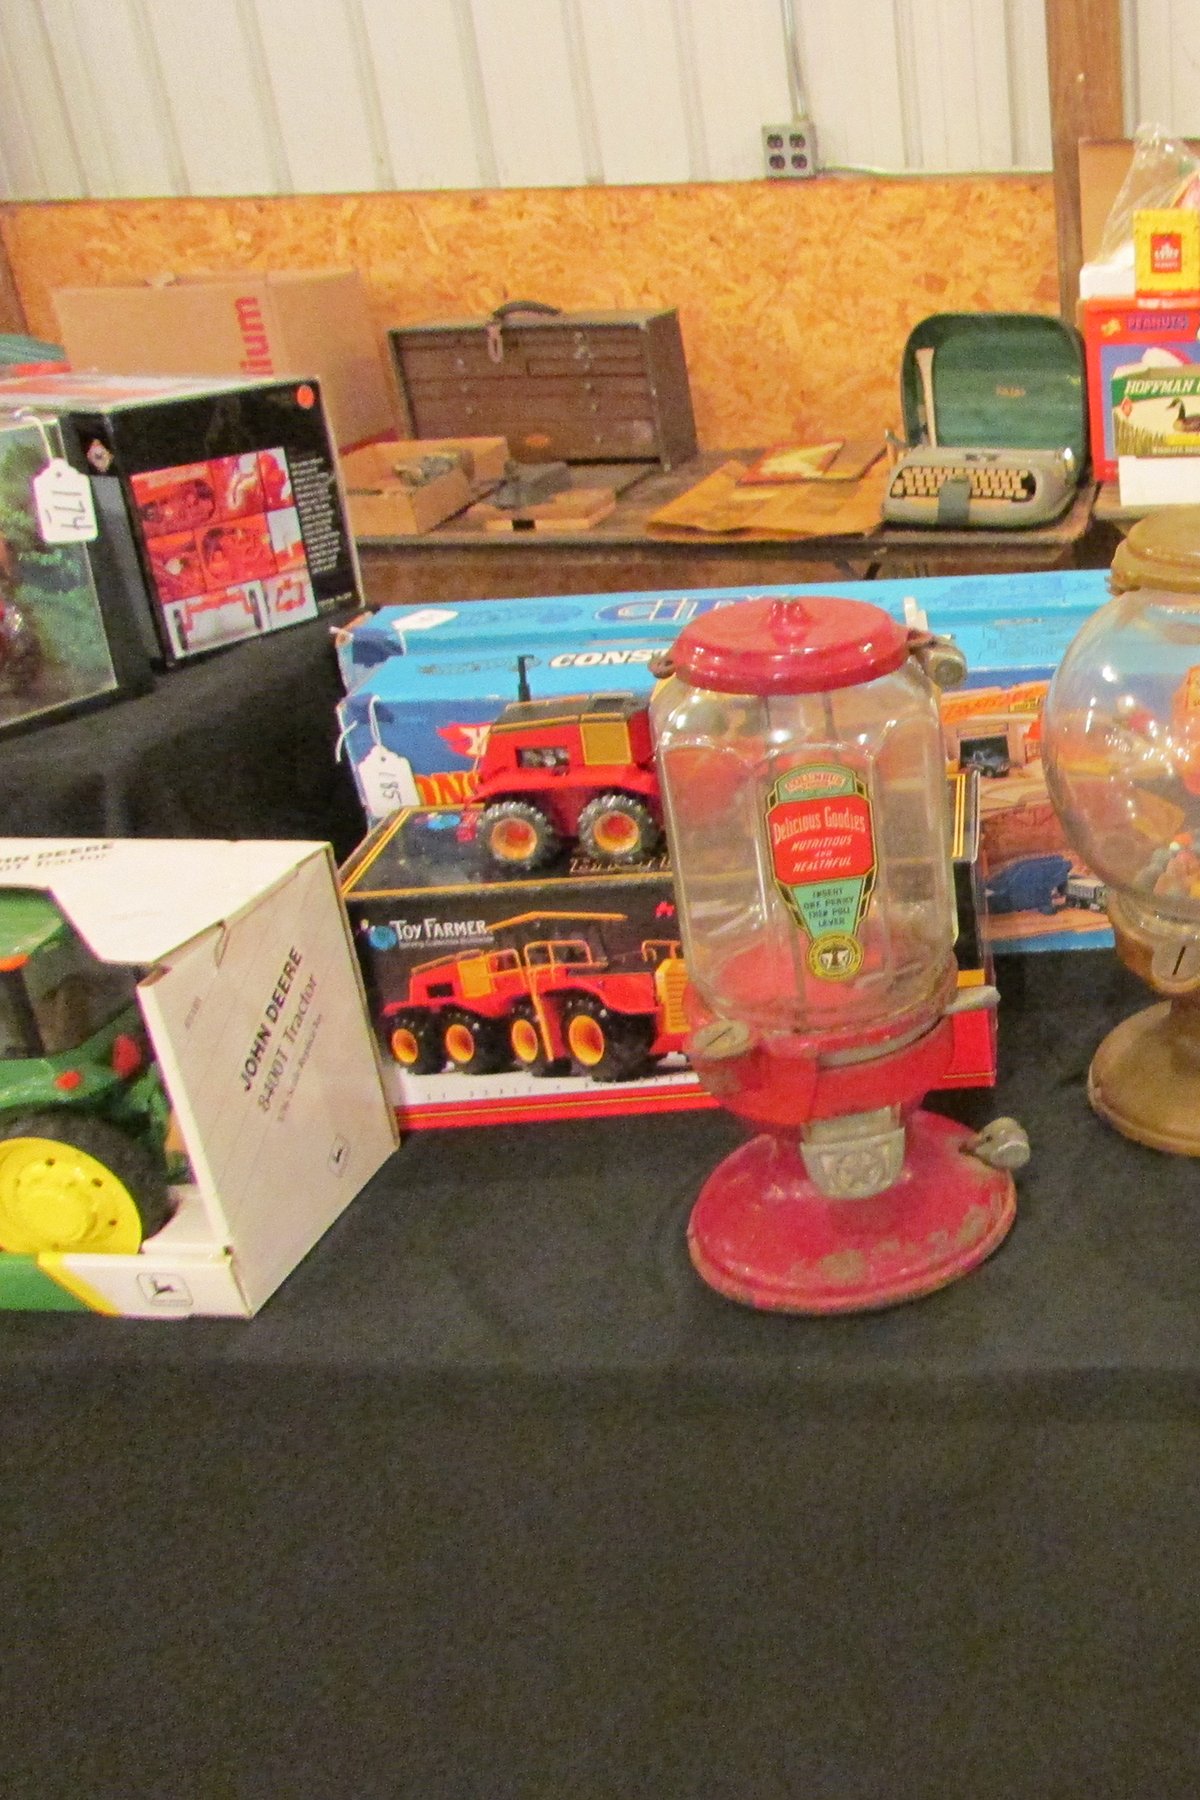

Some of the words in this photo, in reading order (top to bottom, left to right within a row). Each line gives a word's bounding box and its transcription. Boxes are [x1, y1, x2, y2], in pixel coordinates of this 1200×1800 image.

[1124, 377, 1193, 394] HOFFMAN
[773, 813, 822, 845] Delicious
[824, 806, 866, 832] Goodies
[790, 835, 853, 852] NUTRITIOUS
[793, 857, 852, 873] HEALTHFUL
[423, 917, 488, 939] FARMER
[241, 1022, 272, 1092] JOHN
[266, 945, 302, 1024] DEERE
[283, 974, 318, 1044] Tractor
